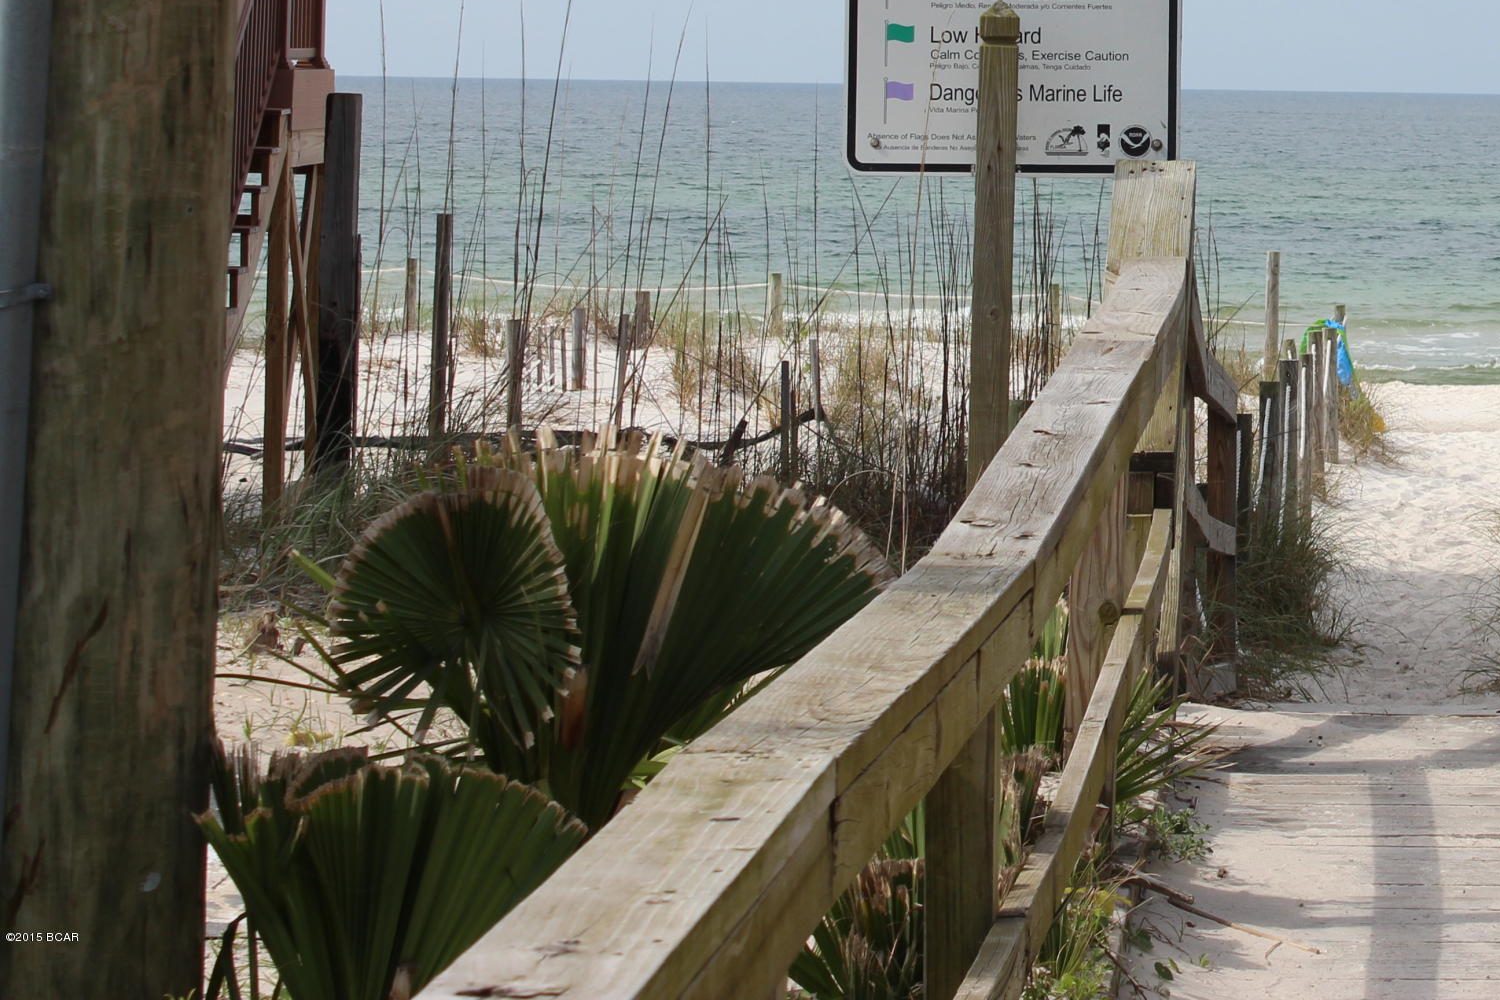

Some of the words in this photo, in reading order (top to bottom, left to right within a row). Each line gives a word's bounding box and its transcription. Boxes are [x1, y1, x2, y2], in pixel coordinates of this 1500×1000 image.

[930, 26, 968, 44] Low
[930, 49, 960, 60] Calm
[1032, 50, 1081, 60] Exercise
[1085, 50, 1129, 61] Caution
[930, 83, 1023, 106] Dangs
[1030, 84, 1087, 102] Marine
[1093, 84, 1123, 102] Life
